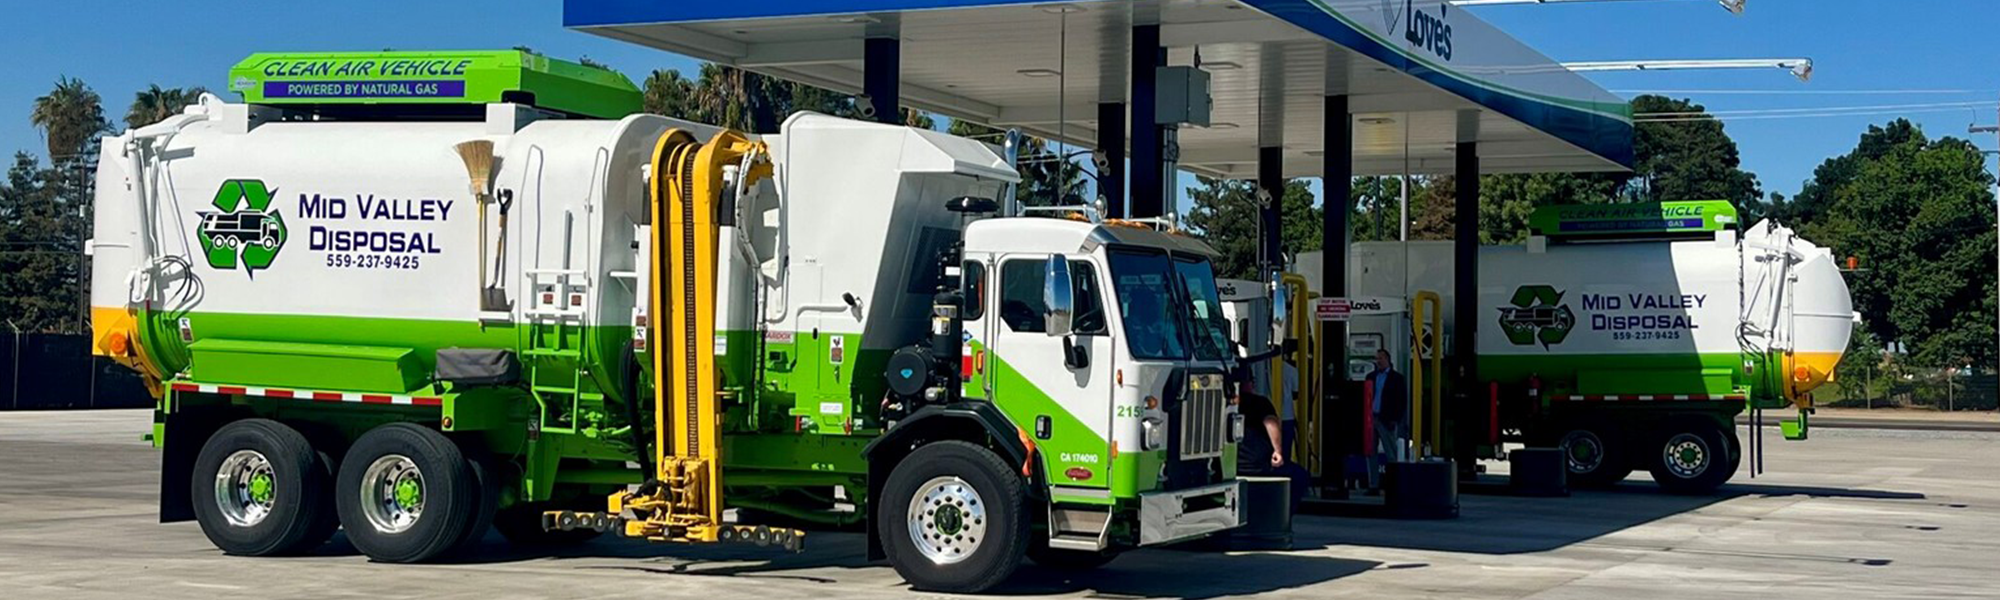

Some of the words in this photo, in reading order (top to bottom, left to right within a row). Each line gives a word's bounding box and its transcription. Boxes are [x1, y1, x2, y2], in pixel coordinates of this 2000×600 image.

[1405, 0, 1452, 61] Love's
[263, 61, 336, 76] CLEAN
[335, 61, 373, 76] AIR
[379, 60, 472, 76] VEHICLE
[287, 83, 342, 95] POWERED
[344, 83, 358, 95] BY
[361, 83, 412, 95] NATURAL
[415, 83, 438, 95] GAS
[299, 193, 346, 219] MID
[356, 194, 454, 221] VALLEY
[1559, 210, 1608, 220] CLEAN
[1612, 208, 1637, 219] AIR
[1640, 206, 1704, 218] VEHICLE
[309, 226, 441, 254] DISPOSAL
[326, 254, 420, 270] 559-237-9425
[1350, 299, 1381, 310] Love's
[1581, 293, 1622, 310] MID
[1628, 293, 1707, 309] VALLEY
[1591, 314, 1699, 330] DISPOSAL
[1613, 331, 1680, 340] 559-237-9425
[1060, 452, 1071, 462] CA
[1072, 453, 1098, 463] 174010
